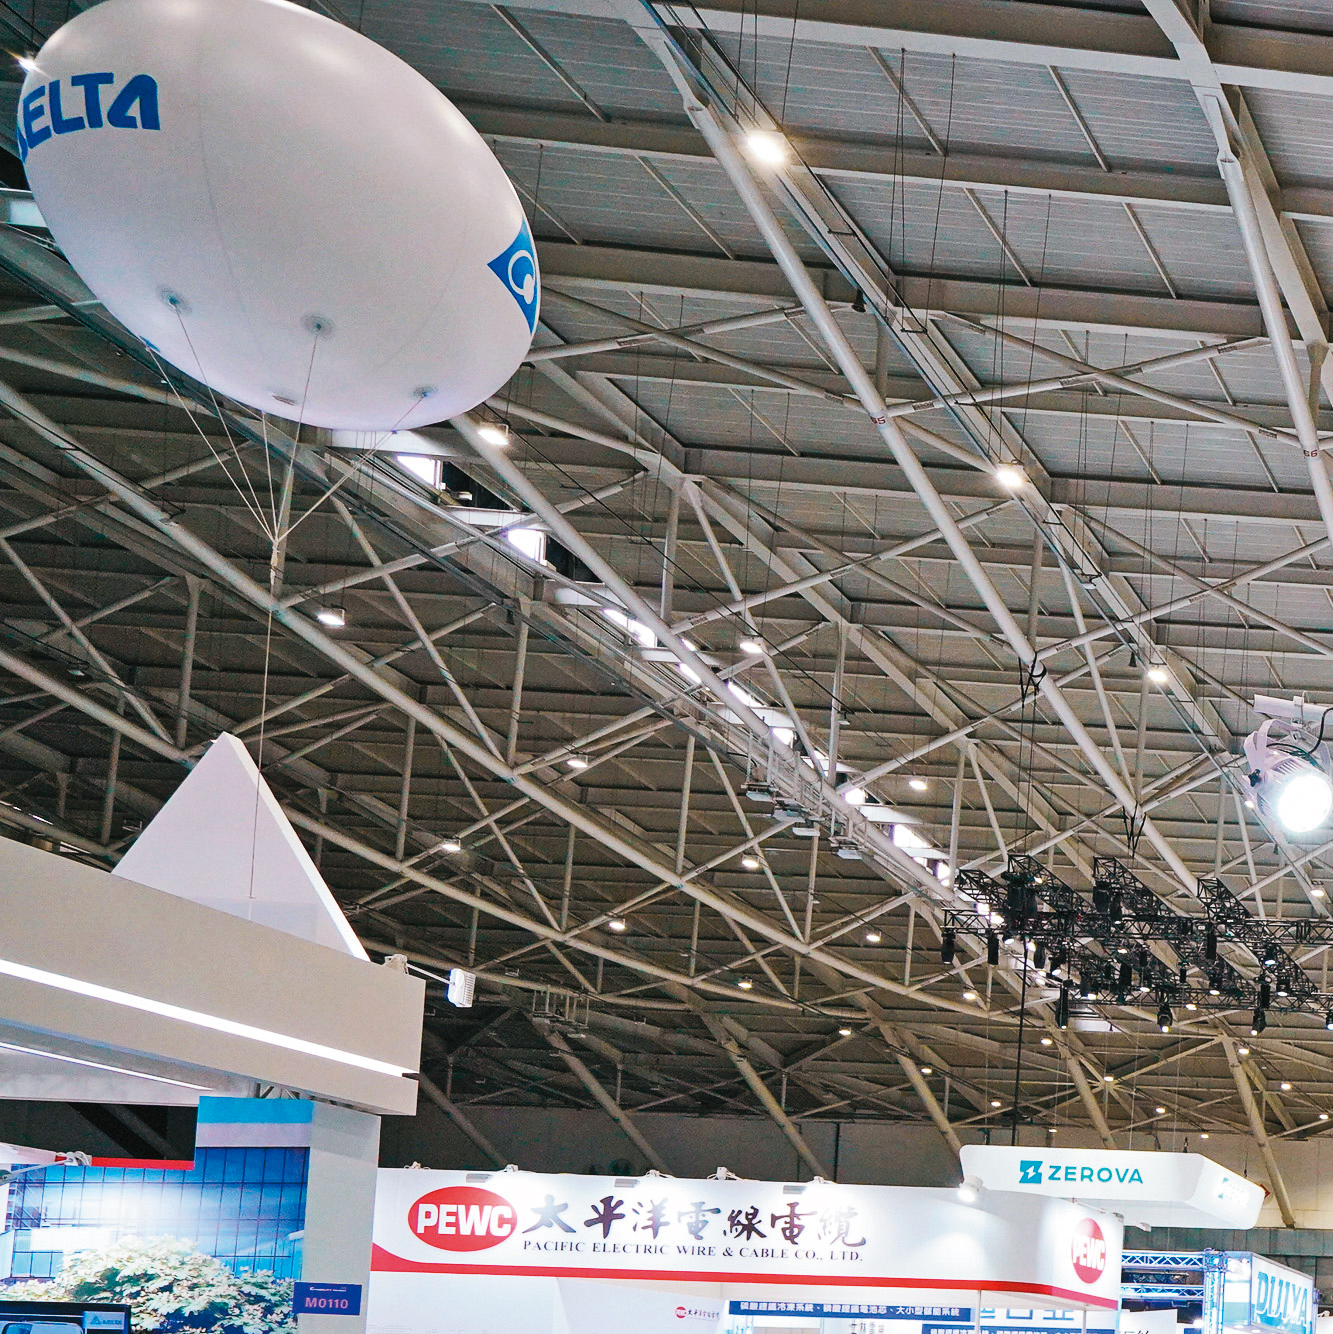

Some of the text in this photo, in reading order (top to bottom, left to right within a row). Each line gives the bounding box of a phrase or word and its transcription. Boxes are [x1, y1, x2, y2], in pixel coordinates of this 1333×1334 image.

[16, 72, 161, 163] ELTA
[1047, 1164, 1145, 1184] ZEROVA
[417, 1203, 514, 1237] PEWC
[521, 1193, 868, 1248] 太平洋電線電纜
[523, 1240, 586, 1254] PACIFIC
[592, 1241, 671, 1256] ELECTRIC
[676, 1244, 718, 1258] WIRE
[722, 1246, 734, 1258] &
[739, 1246, 790, 1260] CABLE
[829, 1249, 864, 1262] LTD.
[1071, 1234, 1106, 1271] PEWC
[304, 1296, 349, 1310] M0110
